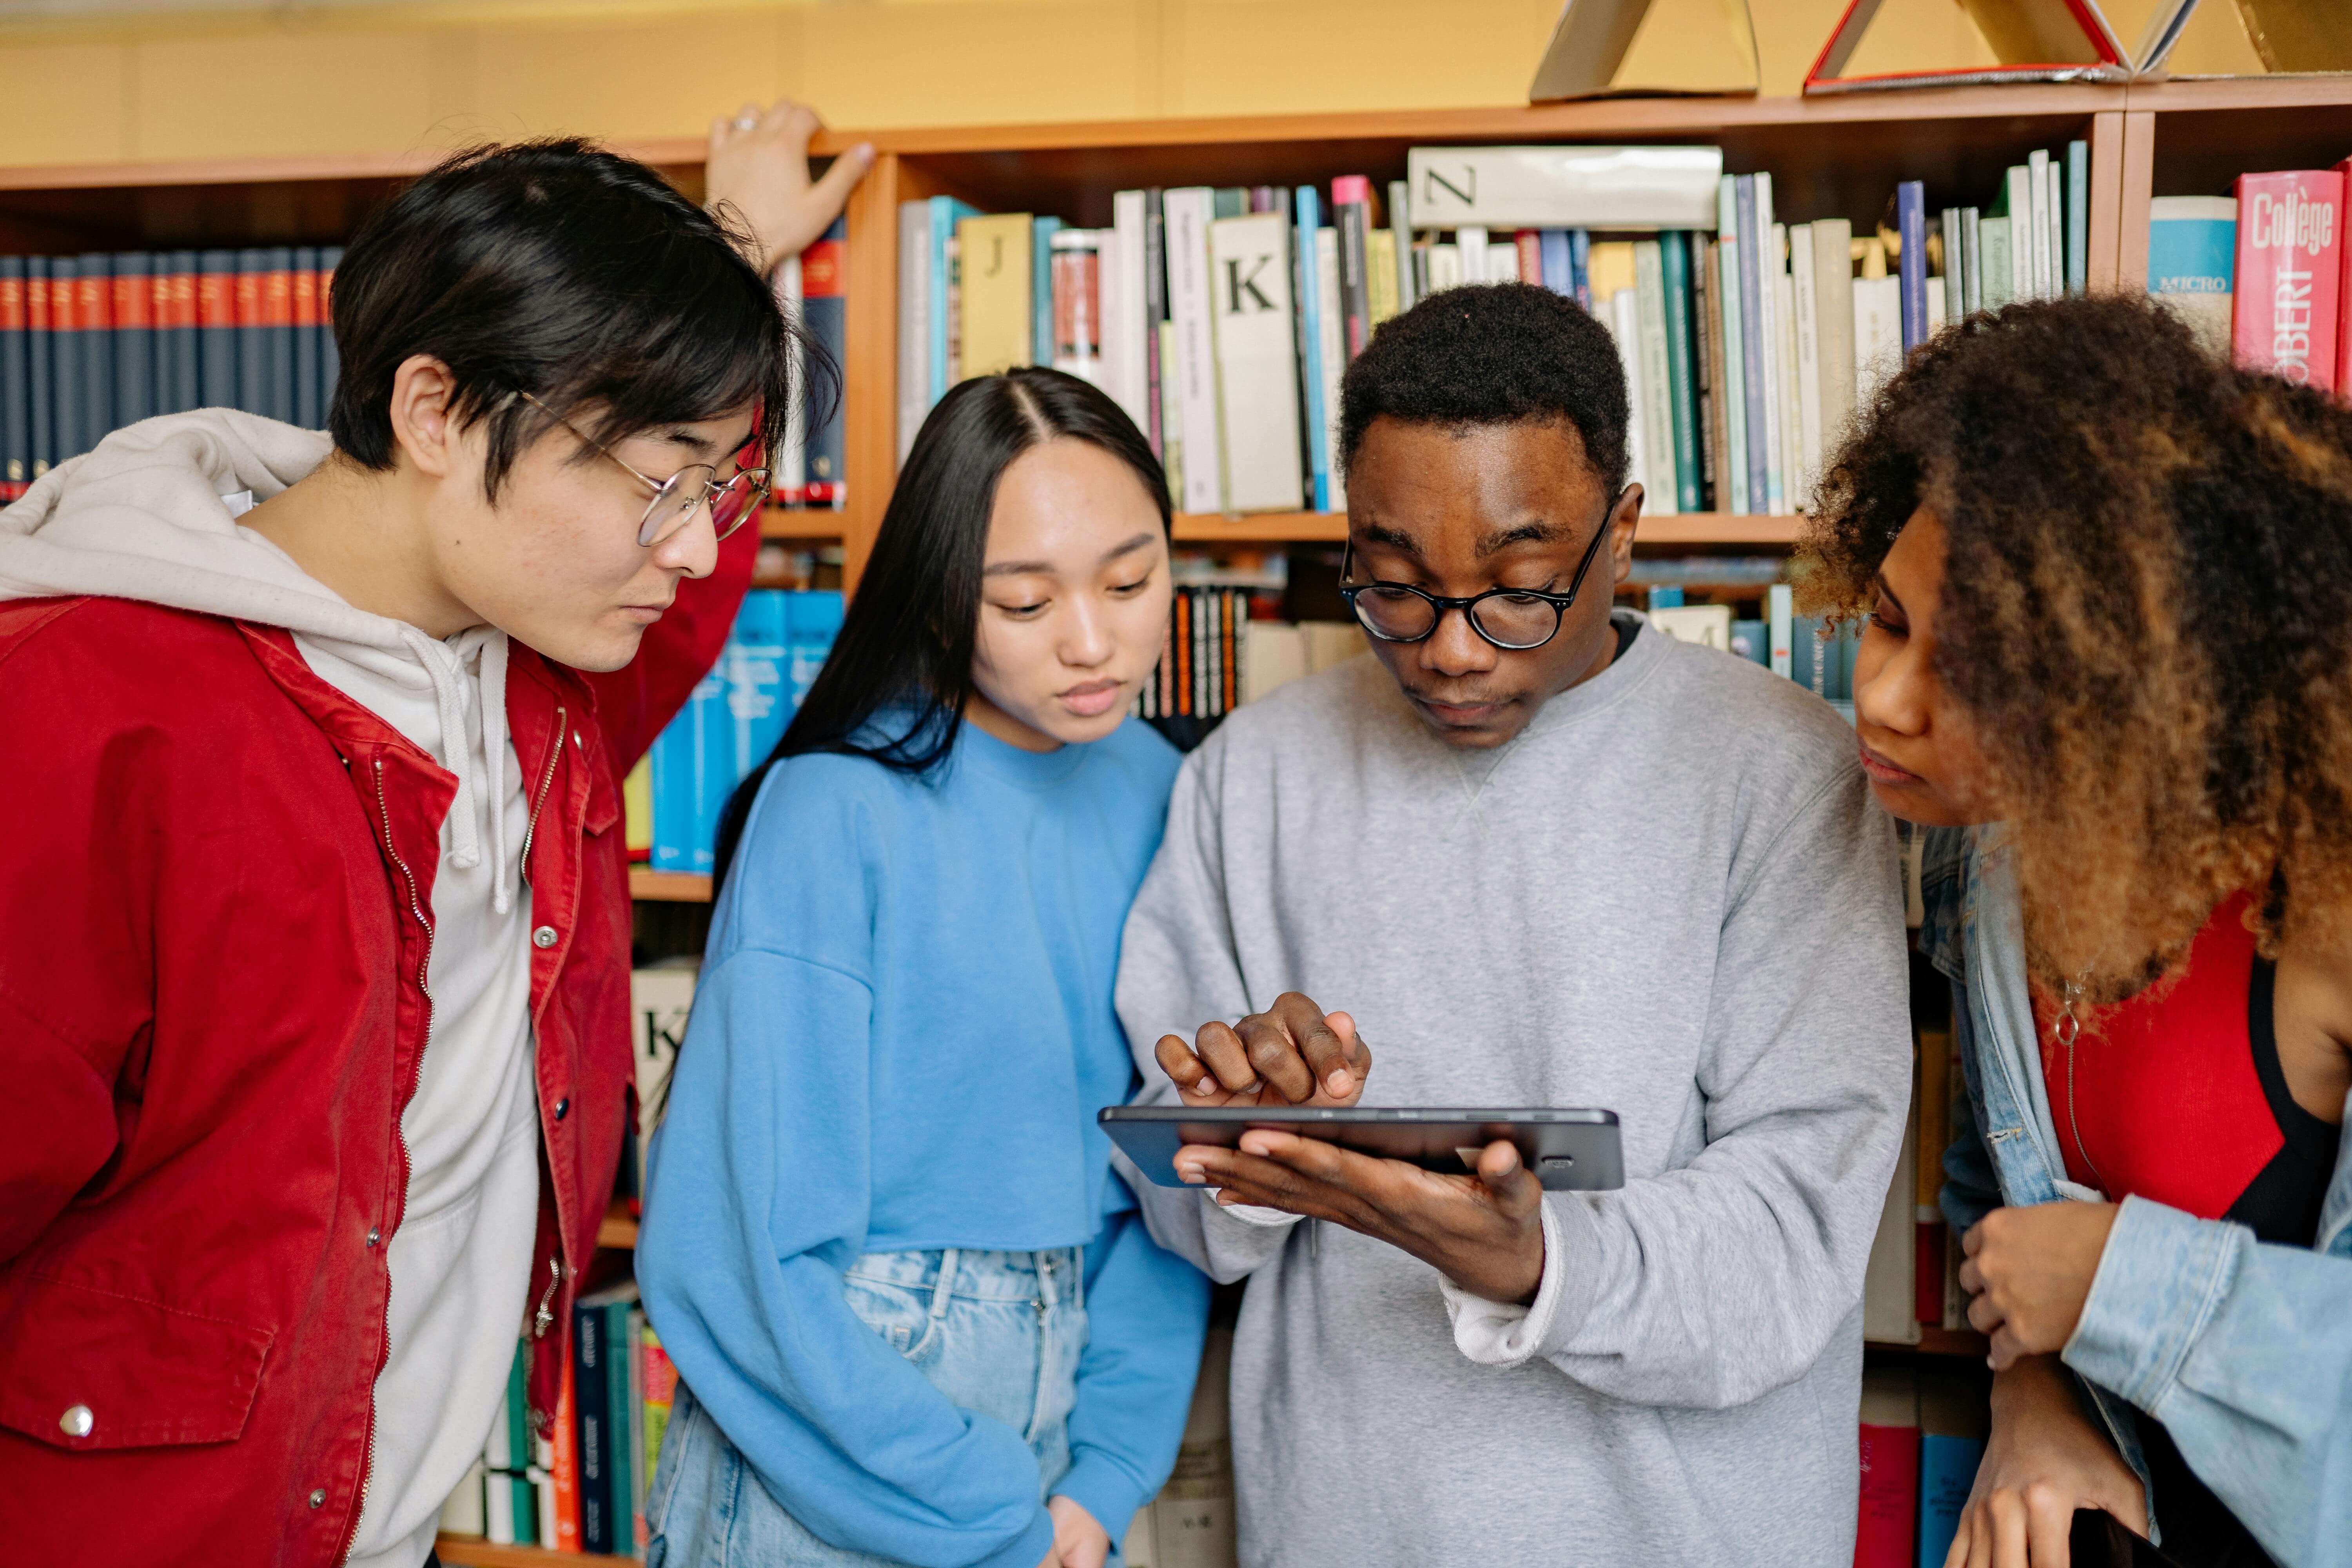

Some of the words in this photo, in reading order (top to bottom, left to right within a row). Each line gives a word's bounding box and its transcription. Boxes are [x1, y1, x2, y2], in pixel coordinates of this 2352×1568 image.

[2252, 186, 2333, 256] Collège
[1222, 254, 1279, 315] K
[2160, 276, 2227, 293] MICRO
[2273, 265, 2313, 387] OBERT
[641, 1008, 688, 1060] K
